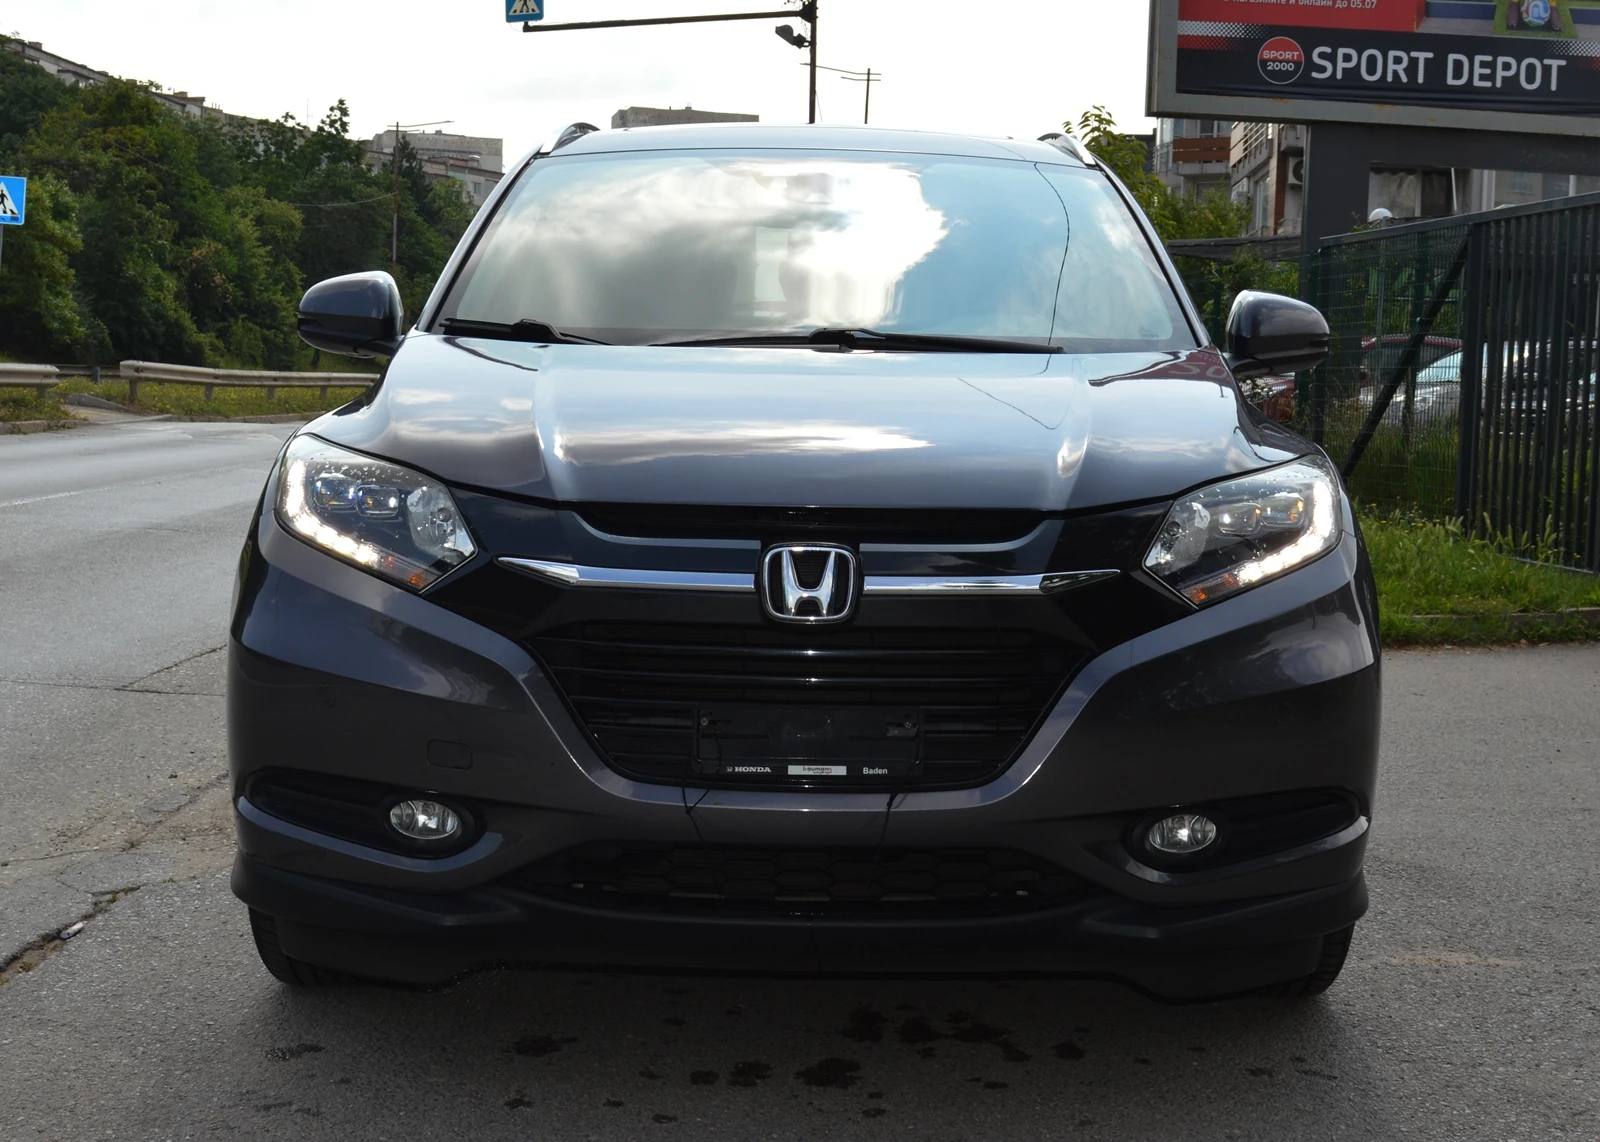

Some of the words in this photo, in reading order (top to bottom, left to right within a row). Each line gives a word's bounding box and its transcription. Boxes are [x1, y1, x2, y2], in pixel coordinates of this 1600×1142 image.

[1335, 0, 1348, 8] до
[1350, 0, 1377, 8] 05.07
[1262, 50, 1300, 60] SPORT
[1266, 61, 1295, 71] 2000
[1310, 46, 1434, 84] SPORT
[1446, 53, 1567, 91] DEPOT
[862, 767, 888, 775] Baden
